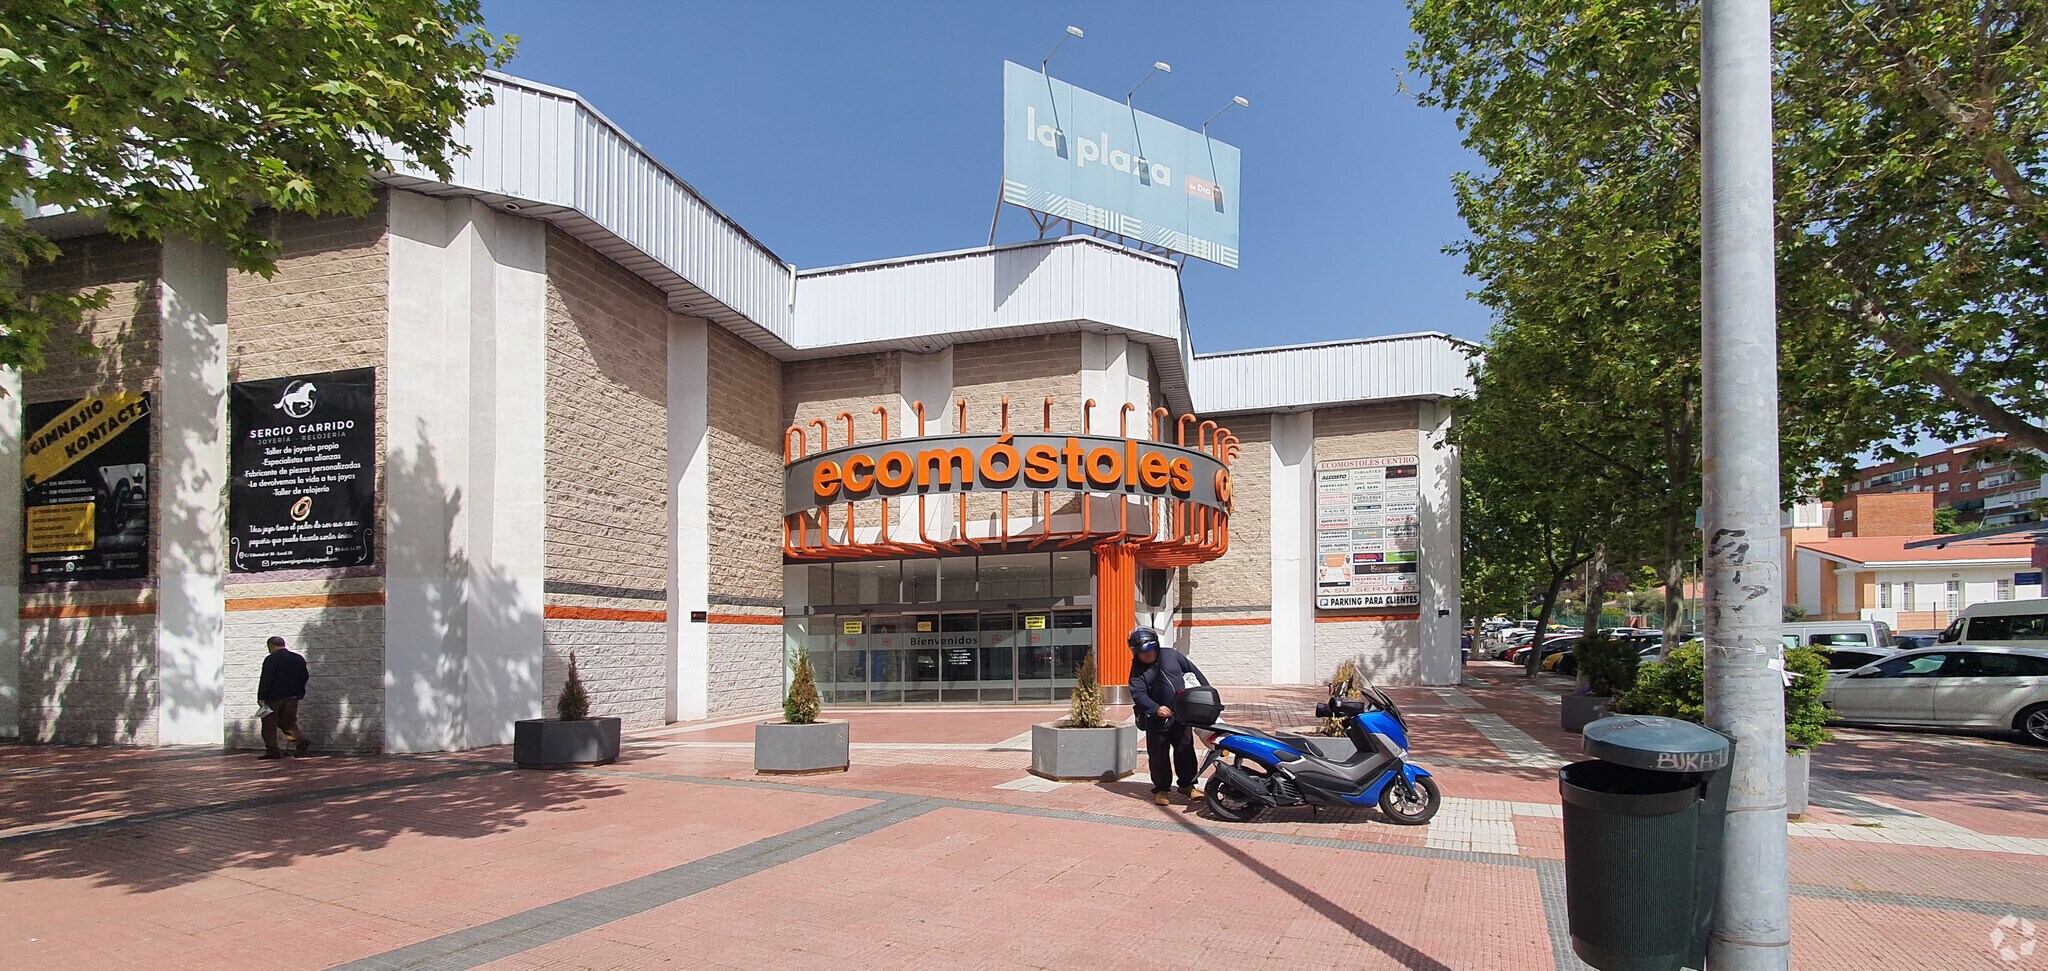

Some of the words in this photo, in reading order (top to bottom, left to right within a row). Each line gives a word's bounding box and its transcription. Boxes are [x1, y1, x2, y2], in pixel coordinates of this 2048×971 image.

[1027, 106, 1063, 150] la
[1077, 132, 1171, 187] plaza
[250, 426, 293, 438] SERGIO
[298, 420, 354, 433] GARRIDO
[294, 443, 316, 455] joyería
[317, 442, 339, 452] propio
[314, 453, 341, 461] alianzas
[1321, 460, 1379, 469] ECOMOSTOLES
[1381, 457, 1415, 465] CENTRO
[288, 466, 311, 477] piezas
[311, 461, 361, 473] personalizadas
[813, 434, 1195, 497] ecomóstoles
[258, 478, 297, 487] devolvemos
[305, 475, 320, 483] vida
[326, 474, 337, 482] tus
[337, 473, 356, 483] joyas
[302, 484, 330, 495] relojería
[1330, 598, 1362, 607] PARKING
[1364, 596, 1384, 605] PARA
[910, 635, 978, 648] Bienvenidos
